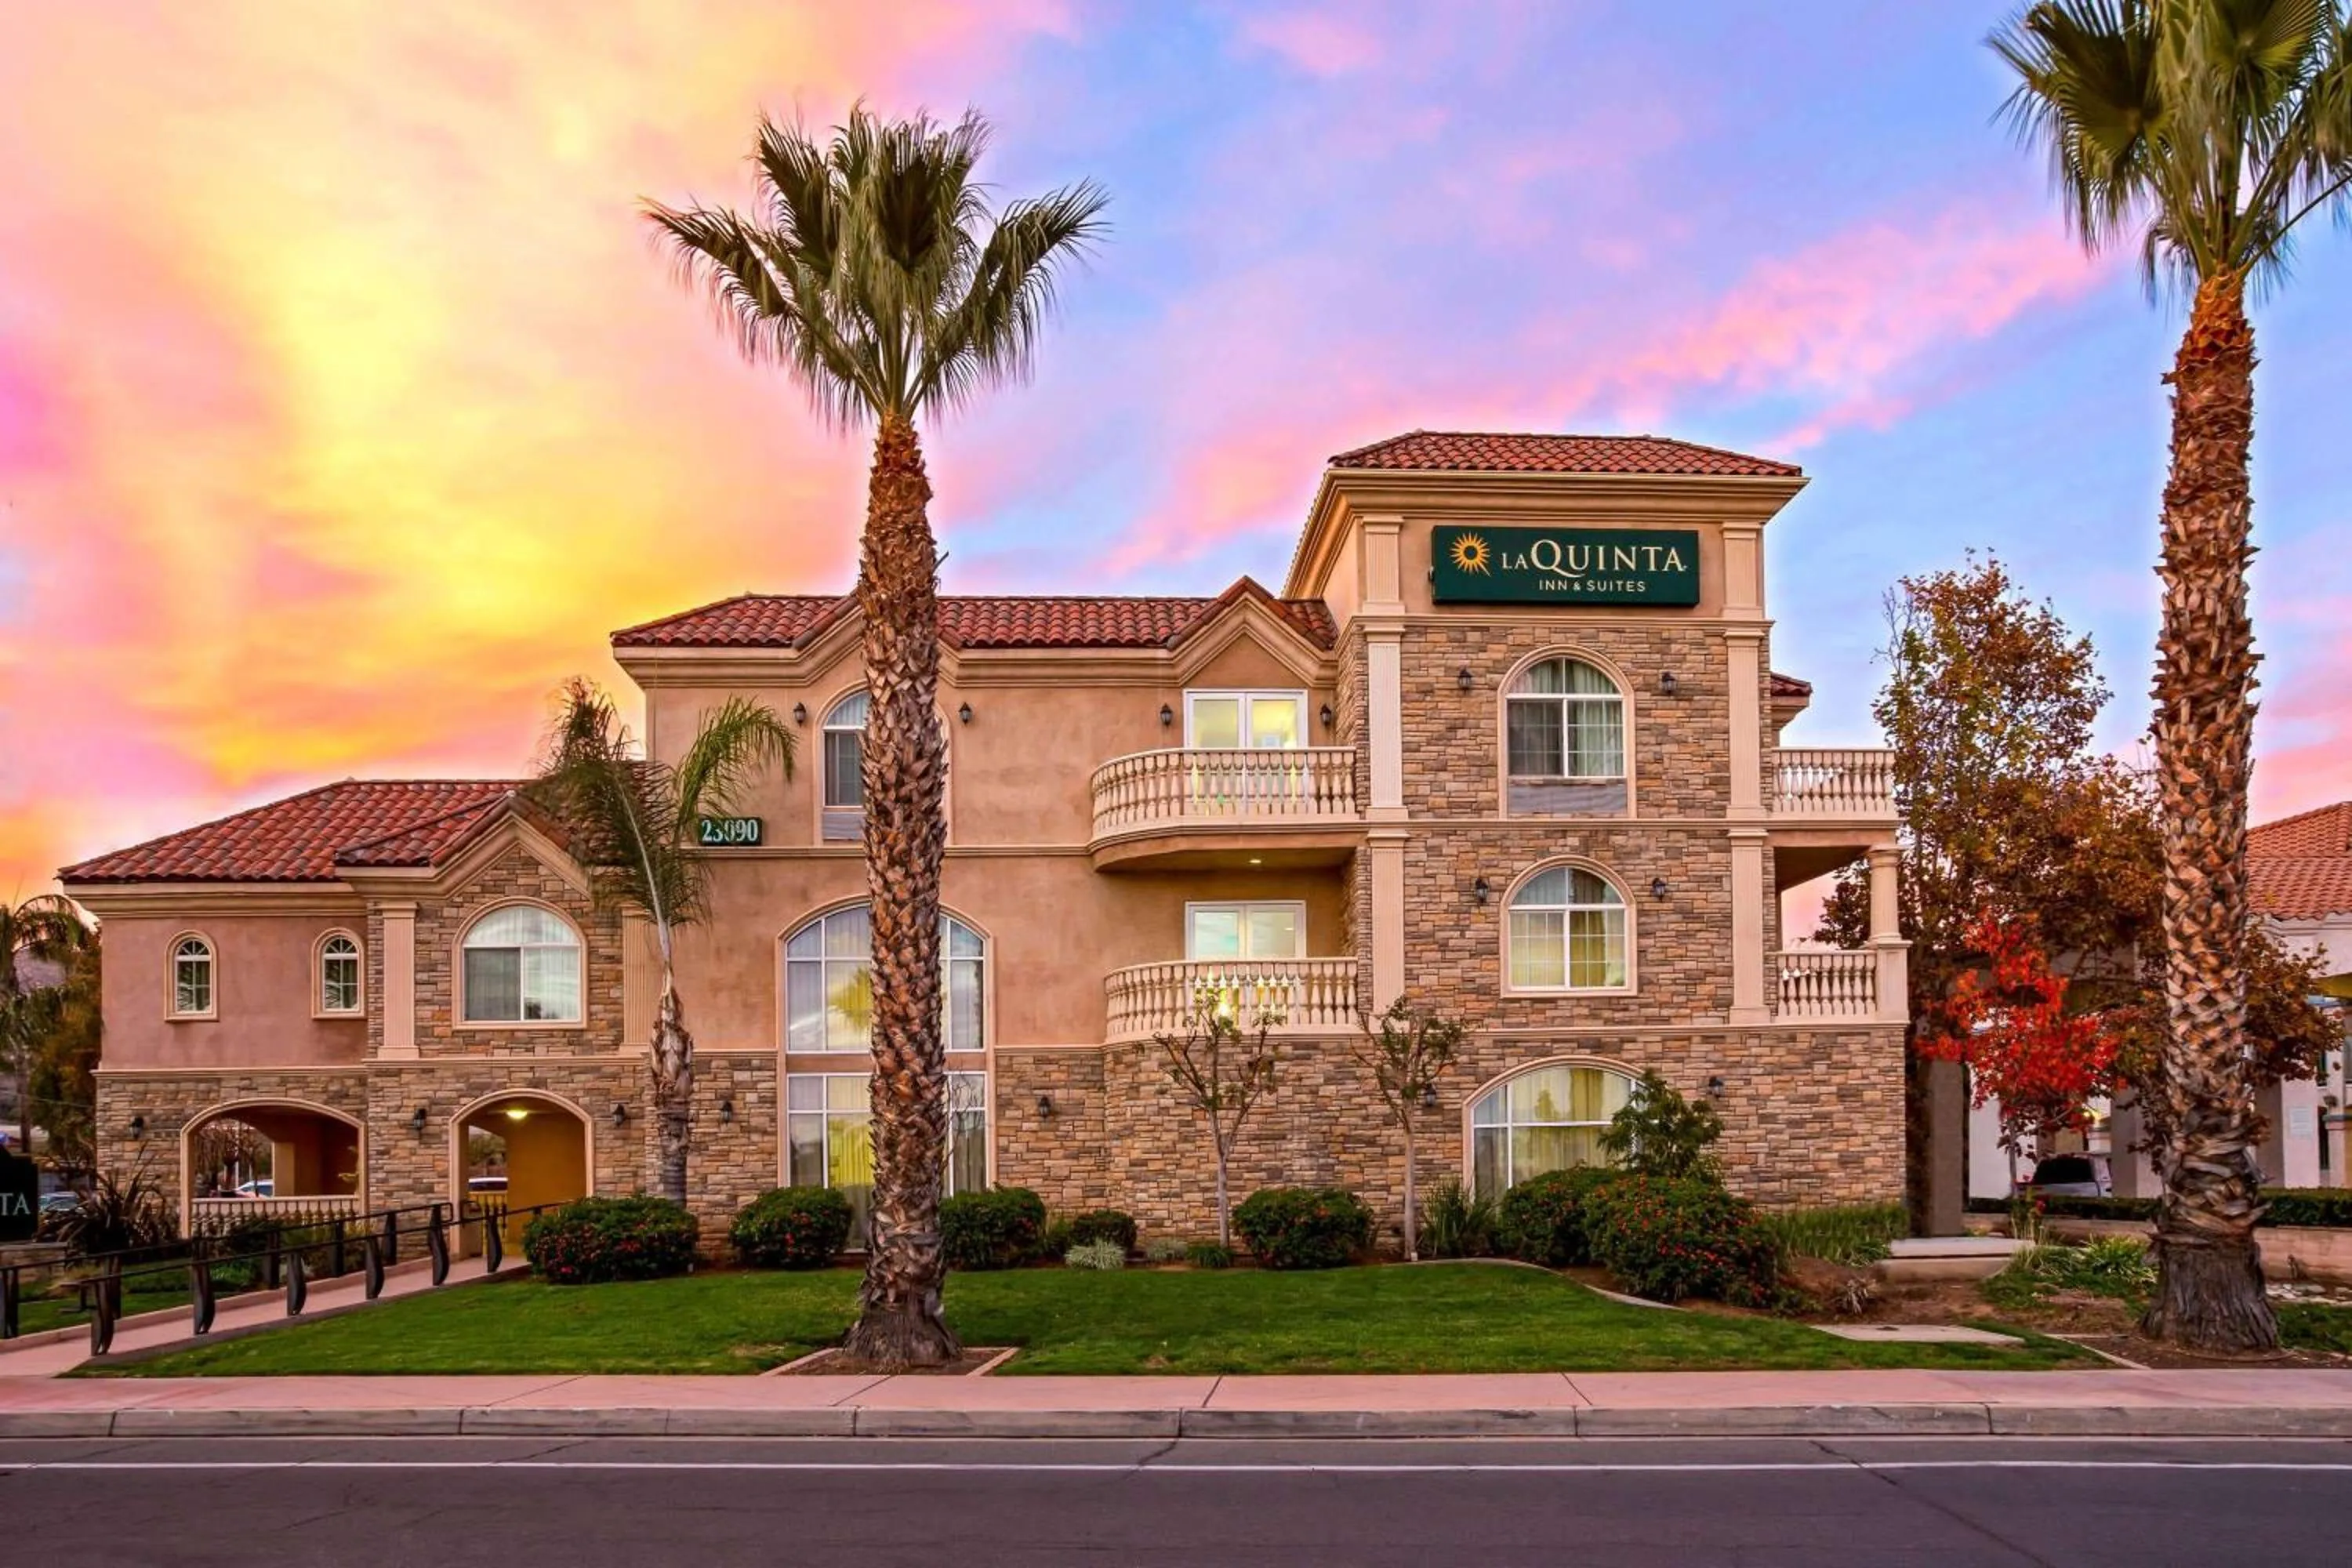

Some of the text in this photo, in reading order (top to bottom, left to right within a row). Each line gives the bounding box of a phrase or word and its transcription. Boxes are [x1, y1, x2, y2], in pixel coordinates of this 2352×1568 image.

[1501, 539, 1686, 578] LA QUINTA
[1539, 579, 1646, 592] INN & SUITES
